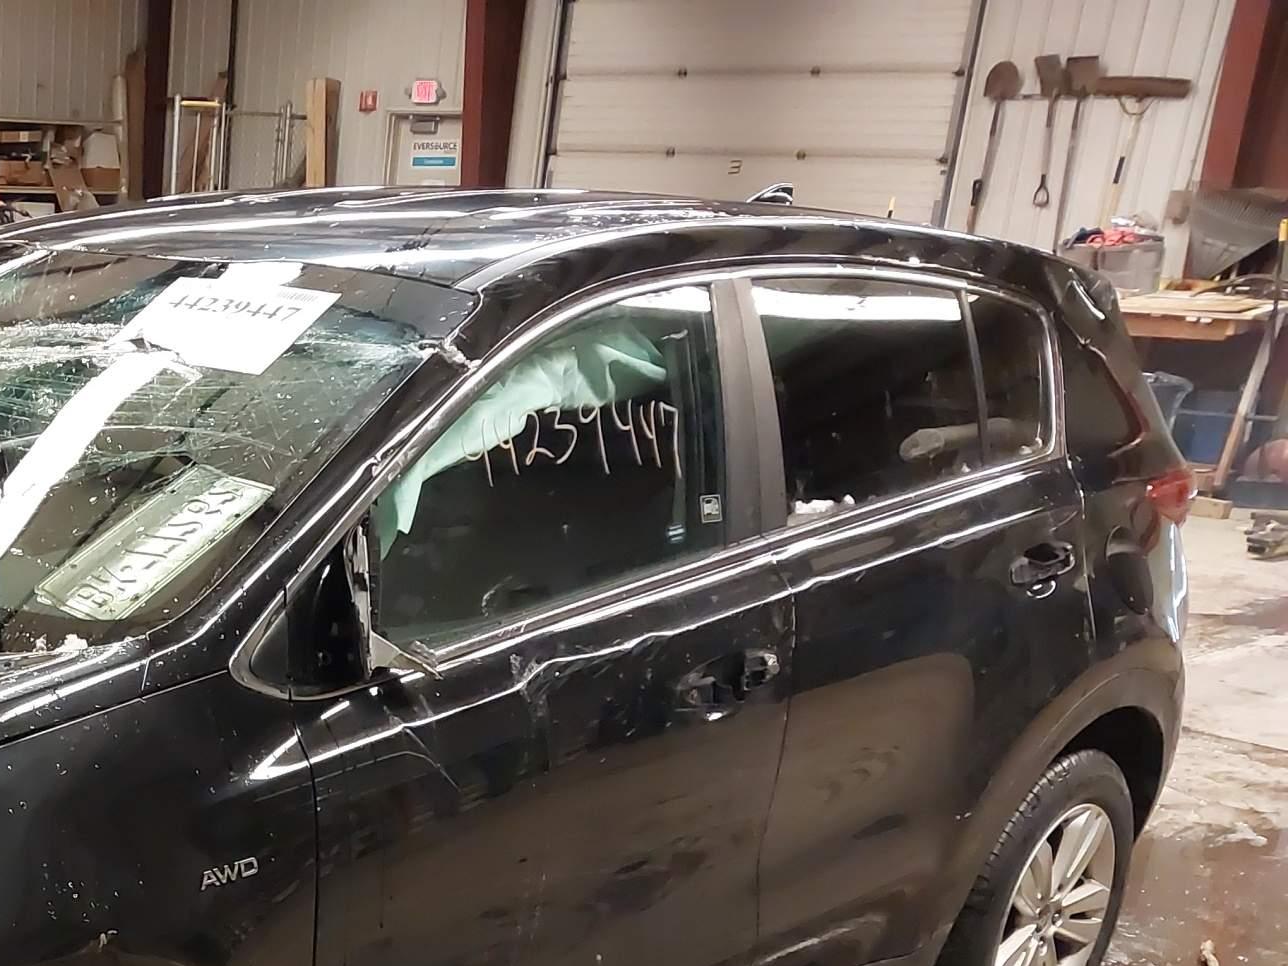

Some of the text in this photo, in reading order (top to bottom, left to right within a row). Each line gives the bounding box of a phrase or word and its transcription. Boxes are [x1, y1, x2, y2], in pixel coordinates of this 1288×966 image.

[168, 294, 303, 322] 44239447
[461, 398, 683, 489] 44239447
[200, 856, 259, 891] AWD
